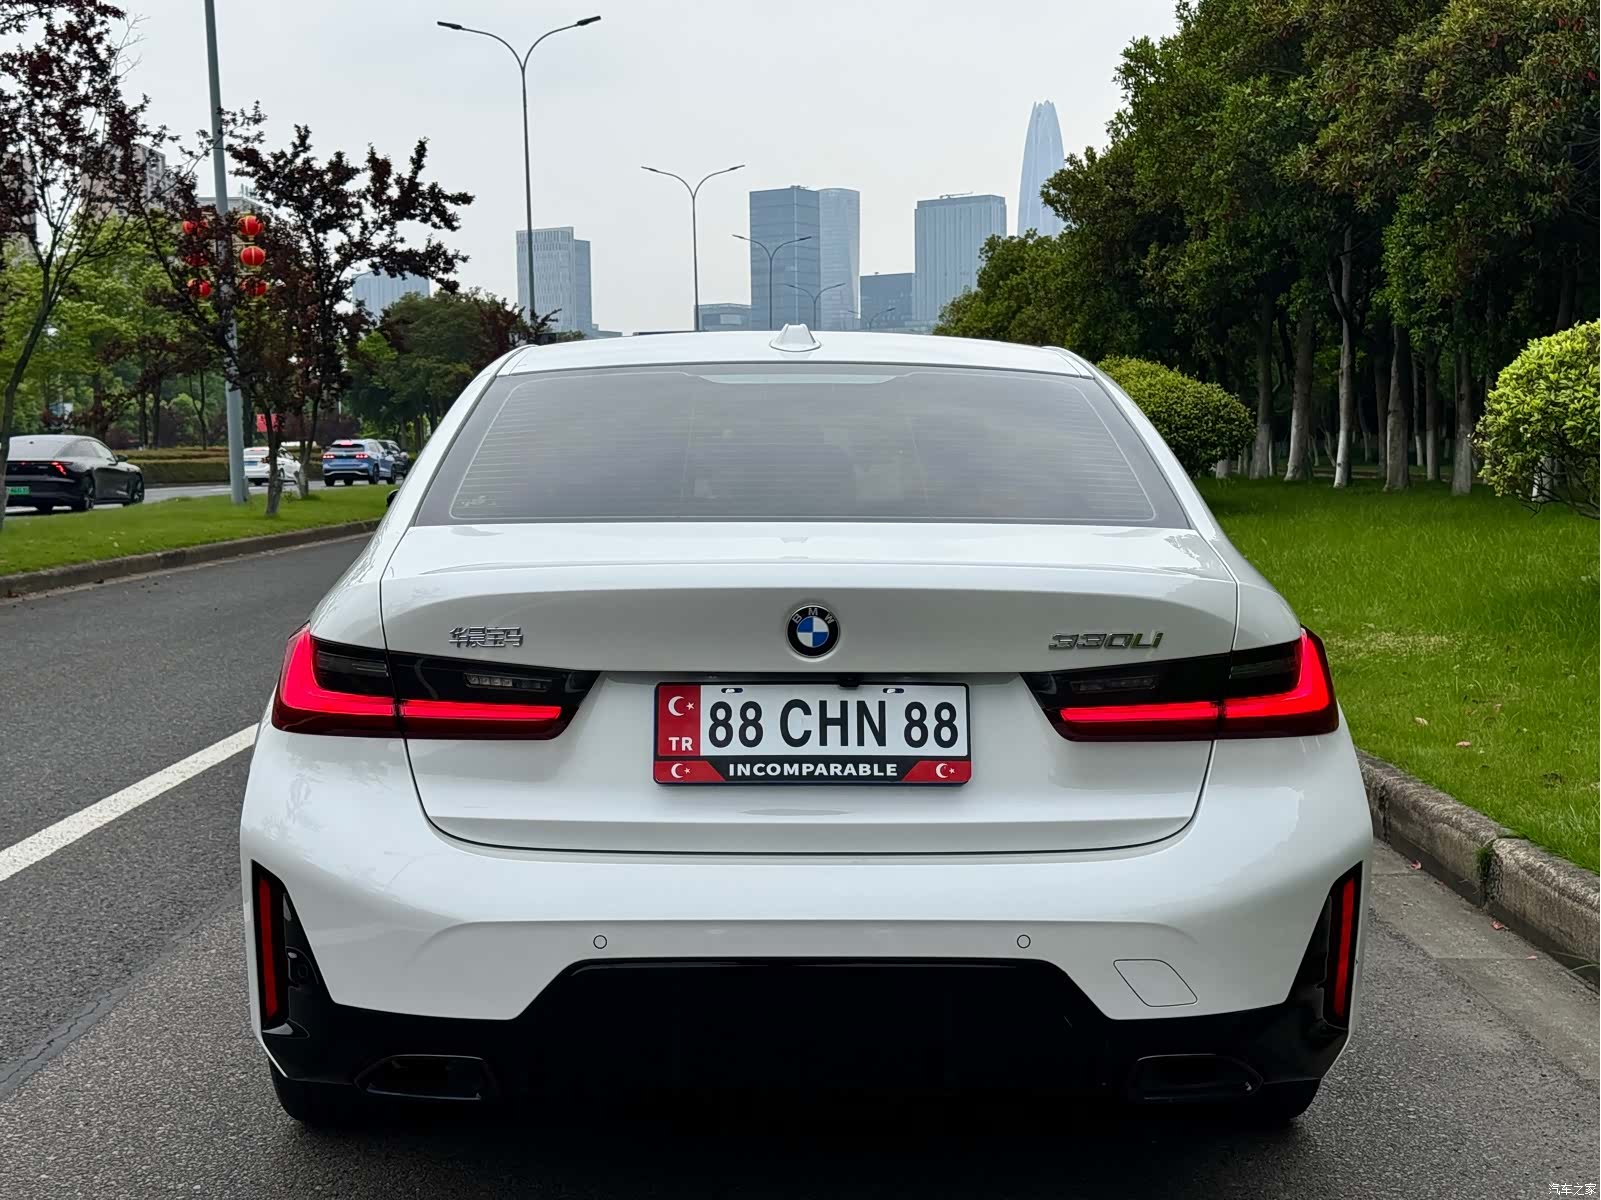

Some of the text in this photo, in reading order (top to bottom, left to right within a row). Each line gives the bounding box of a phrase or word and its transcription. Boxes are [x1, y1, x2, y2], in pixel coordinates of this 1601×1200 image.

[792, 608, 835, 624] BMW
[448, 626, 523, 648] 华晨宝马
[1048, 632, 1164, 650] 330Li
[708, 698, 959, 748] 88 CHN 88
[668, 736, 693, 751] TR
[729, 763, 898, 777] INCOMPARABLE
